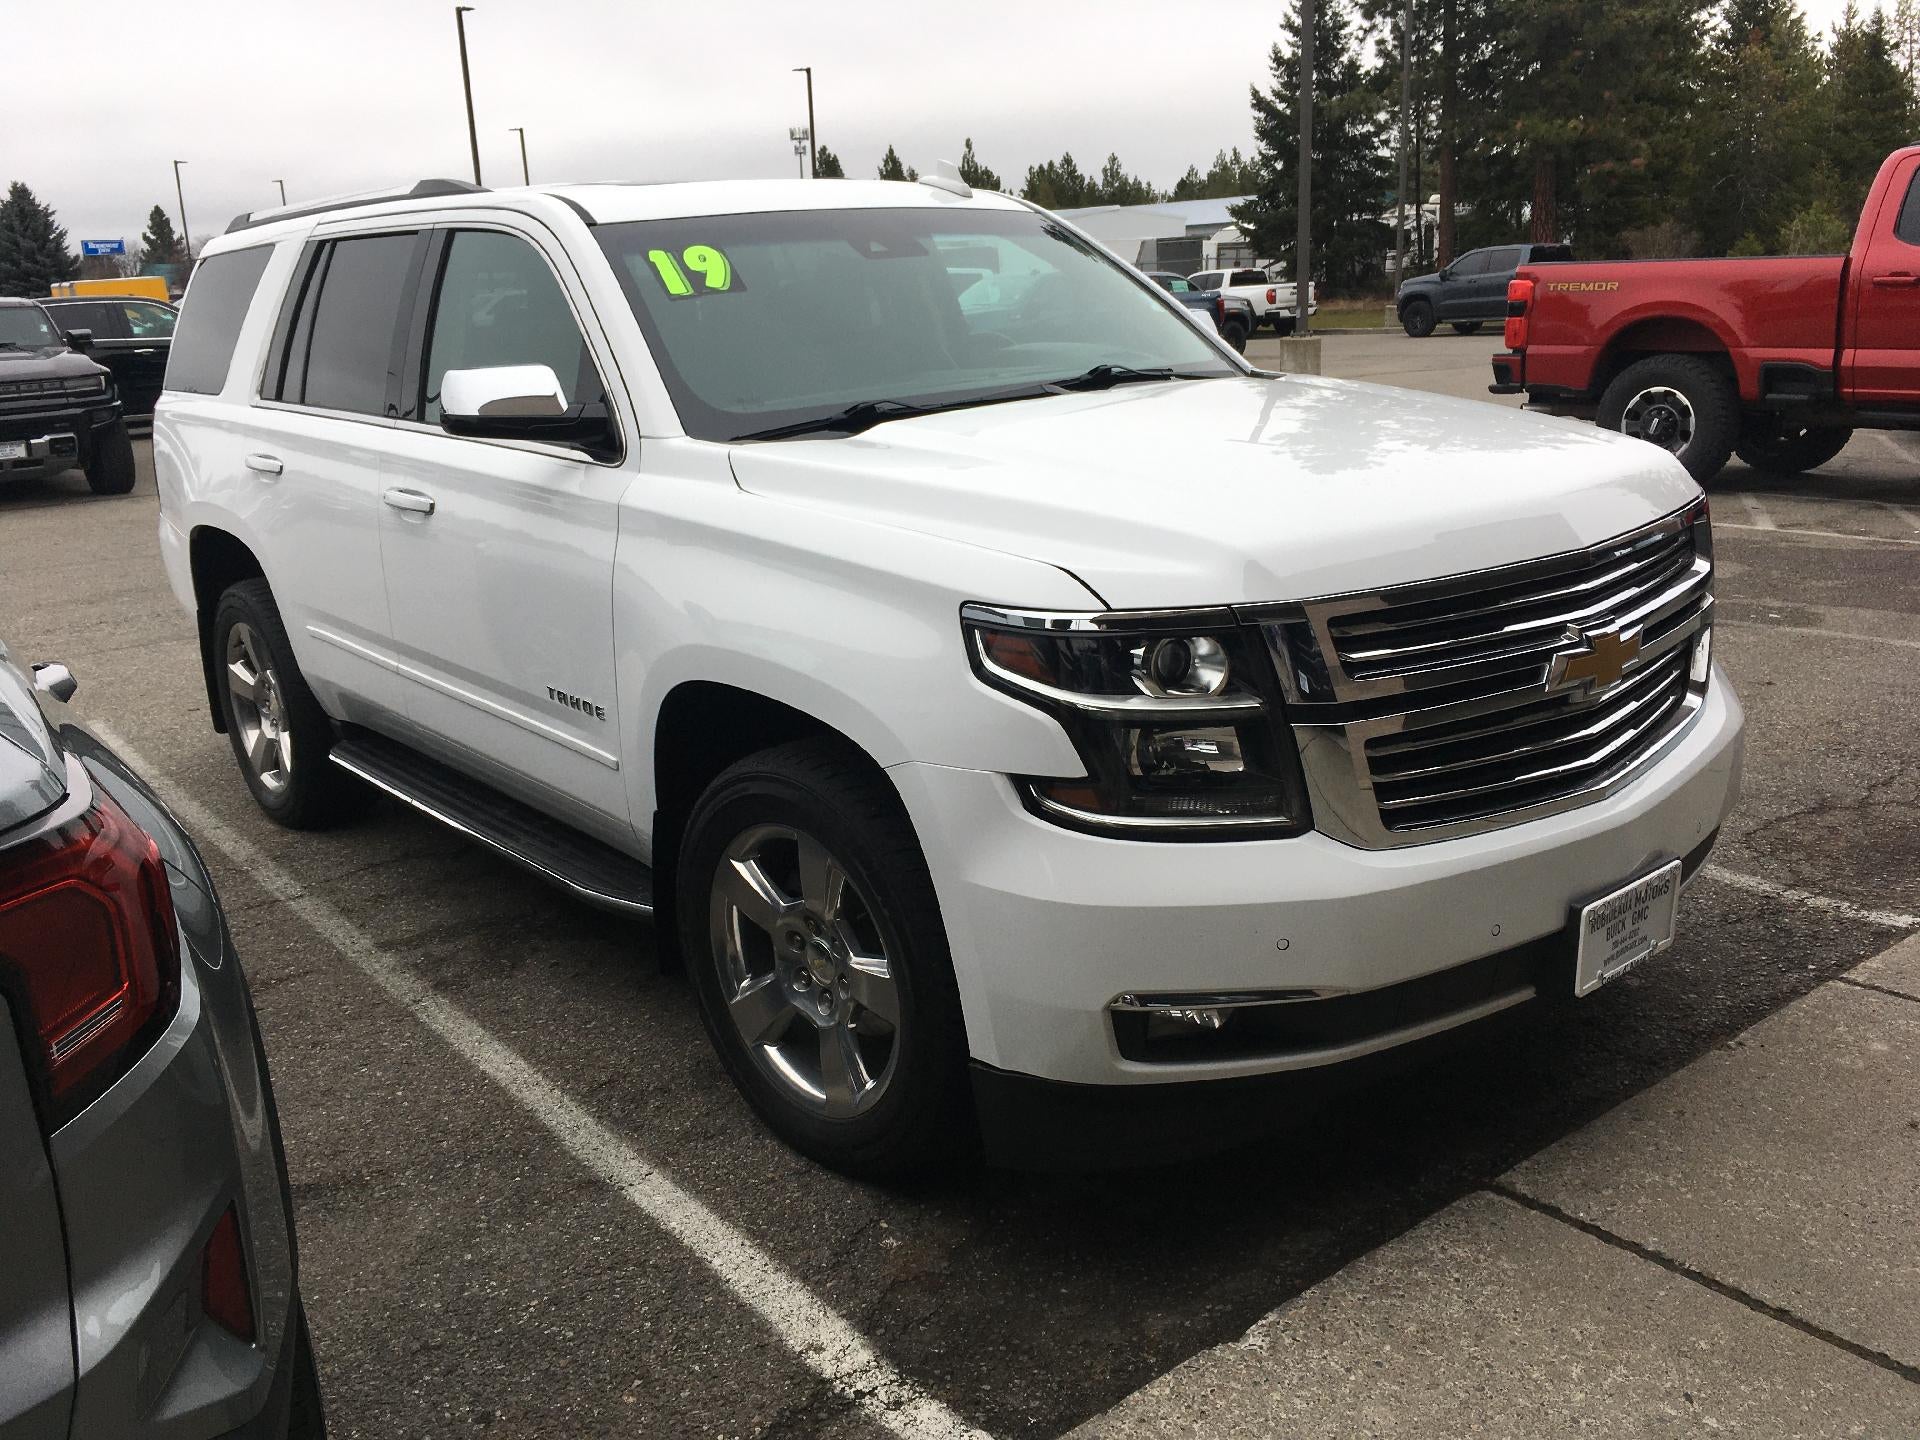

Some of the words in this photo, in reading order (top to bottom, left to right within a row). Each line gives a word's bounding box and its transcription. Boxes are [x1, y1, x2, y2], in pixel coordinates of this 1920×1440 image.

[648, 245, 731, 295] 19
[1546, 281, 1619, 292] TREMOR
[546, 686, 606, 721] TAHOE
[1606, 918, 1626, 941] BUICK
[1632, 905, 1649, 925] GMC
